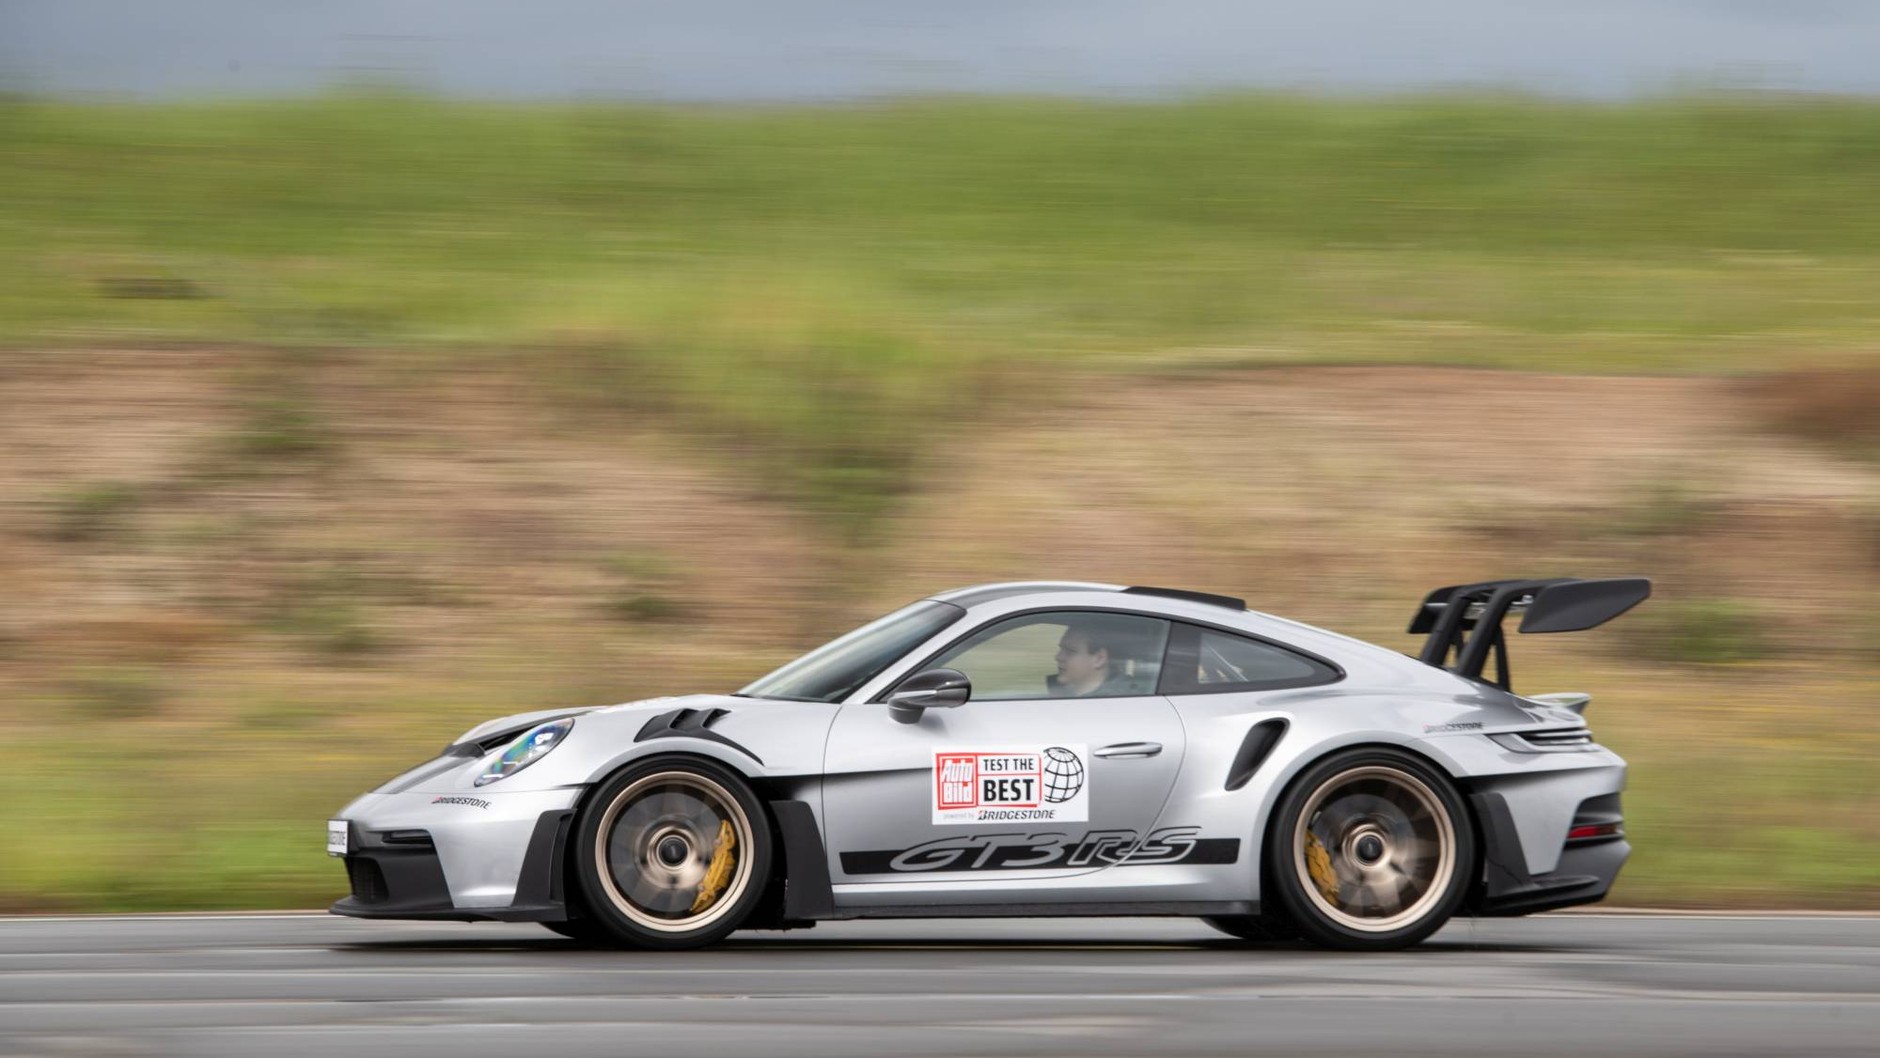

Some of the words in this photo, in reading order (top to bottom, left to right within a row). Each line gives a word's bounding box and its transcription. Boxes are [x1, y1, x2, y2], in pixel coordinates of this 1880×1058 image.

[941, 758, 974, 782] Auto
[983, 758, 1010, 771] TEST
[1014, 758, 1034, 771] THE
[943, 781, 973, 803] Bild
[984, 778, 1034, 802] BEST
[978, 809, 1056, 821] BRIDGESTONE
[890, 832, 1067, 871] GT3
[1067, 825, 1202, 866] RS
